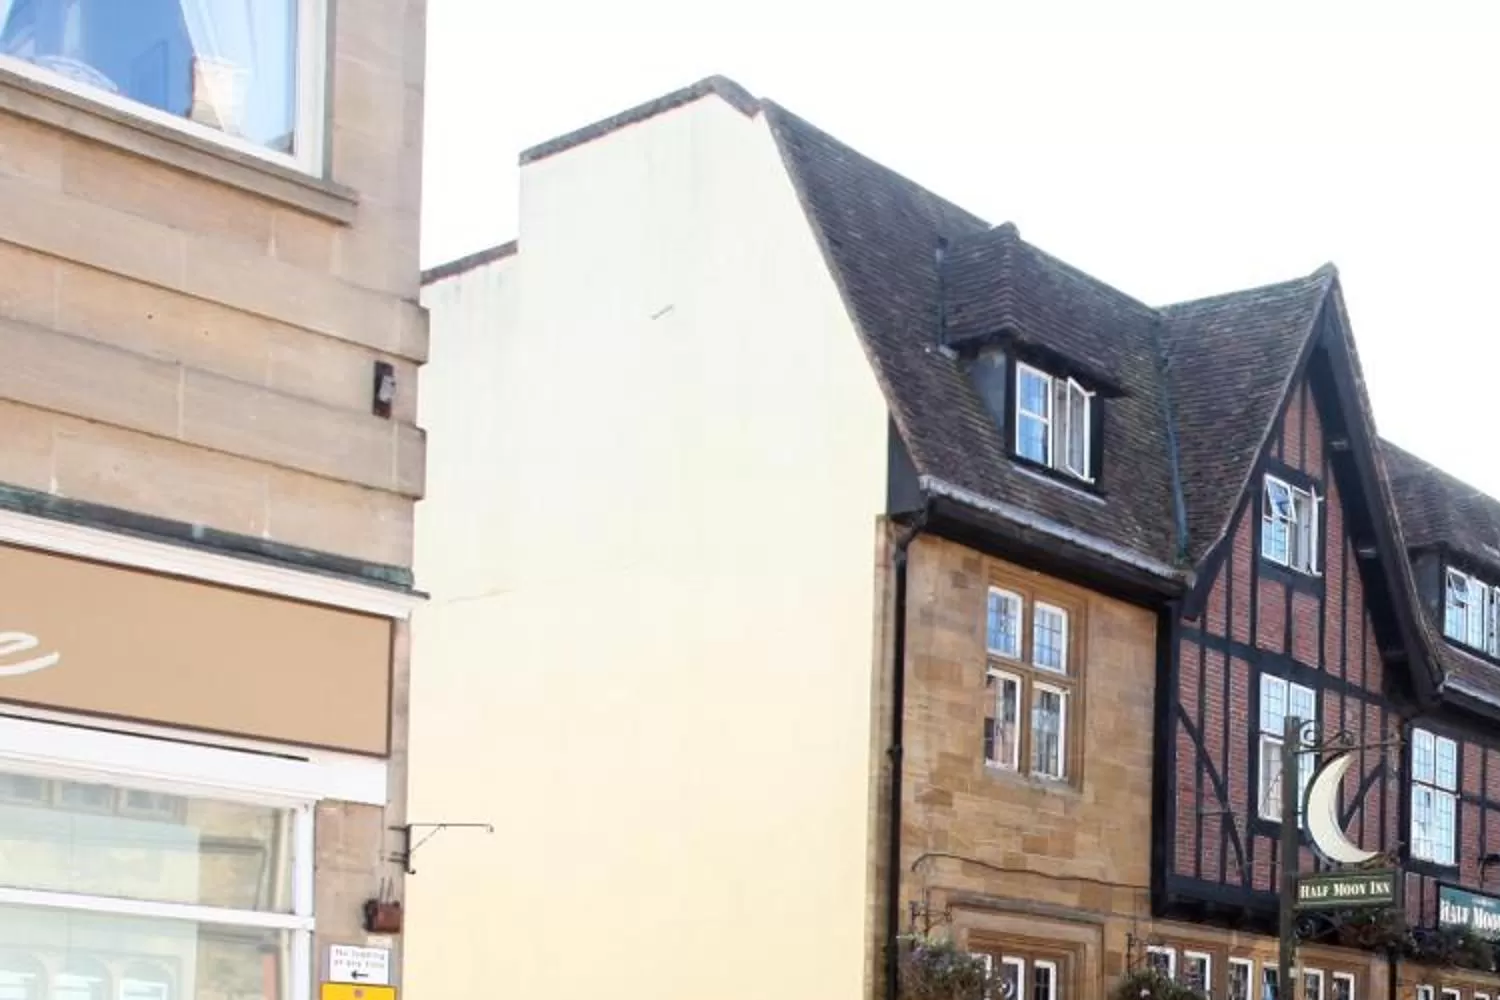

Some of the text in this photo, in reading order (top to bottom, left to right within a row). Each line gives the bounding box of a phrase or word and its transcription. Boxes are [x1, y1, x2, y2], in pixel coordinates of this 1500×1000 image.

[1301, 880, 1391, 899] HALF MOON INN
[1440, 898, 1470, 924] HALF
